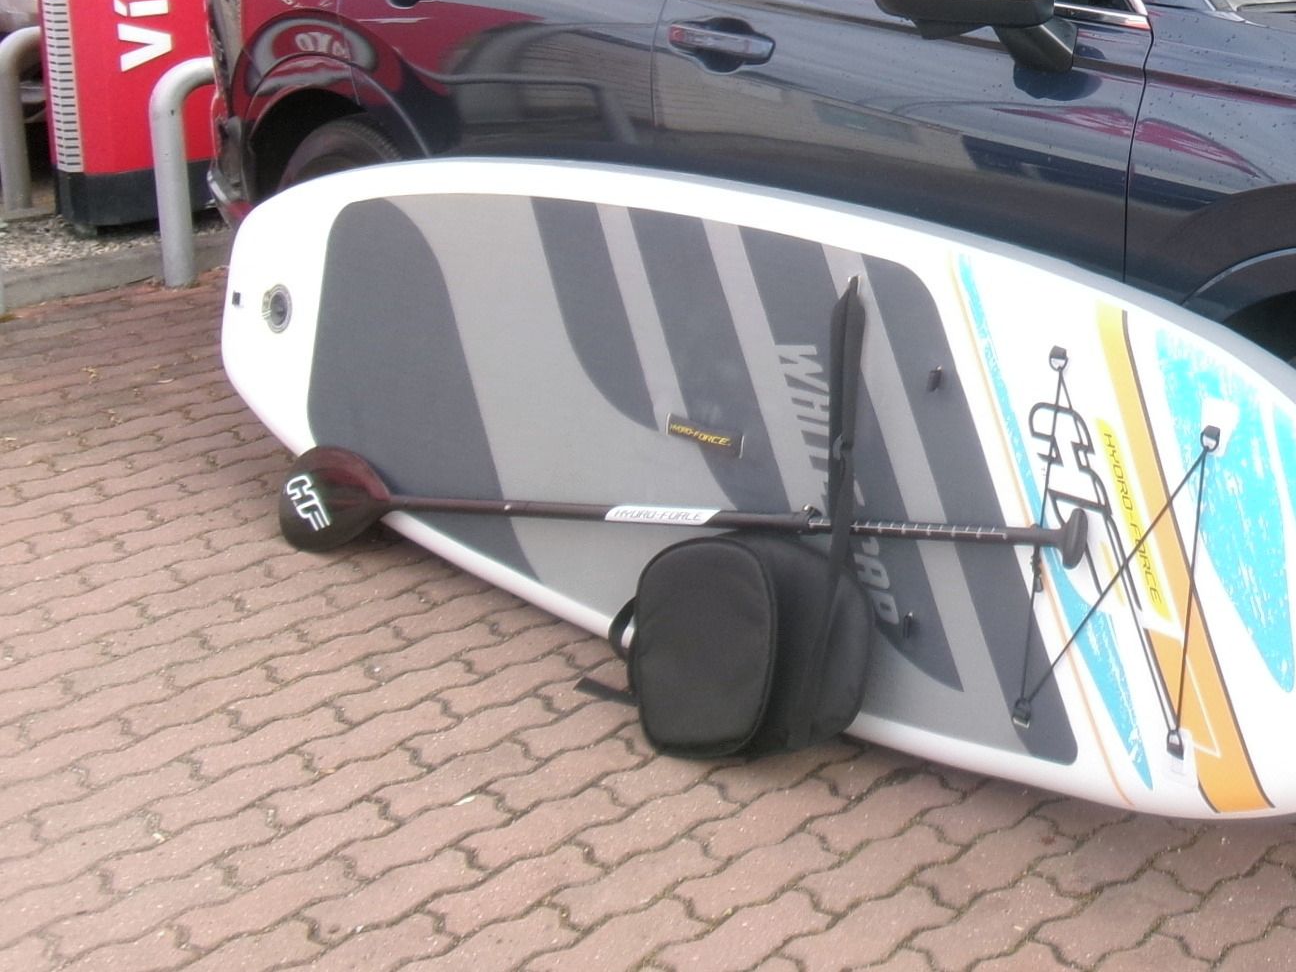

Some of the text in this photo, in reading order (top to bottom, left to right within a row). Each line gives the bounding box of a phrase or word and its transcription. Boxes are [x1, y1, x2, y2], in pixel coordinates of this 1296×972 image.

[670, 423, 733, 447] HYDRO-FORCE
[613, 509, 705, 522] HYDRO-FORCE
[1102, 431, 1164, 605] HYDRO-FORCE
